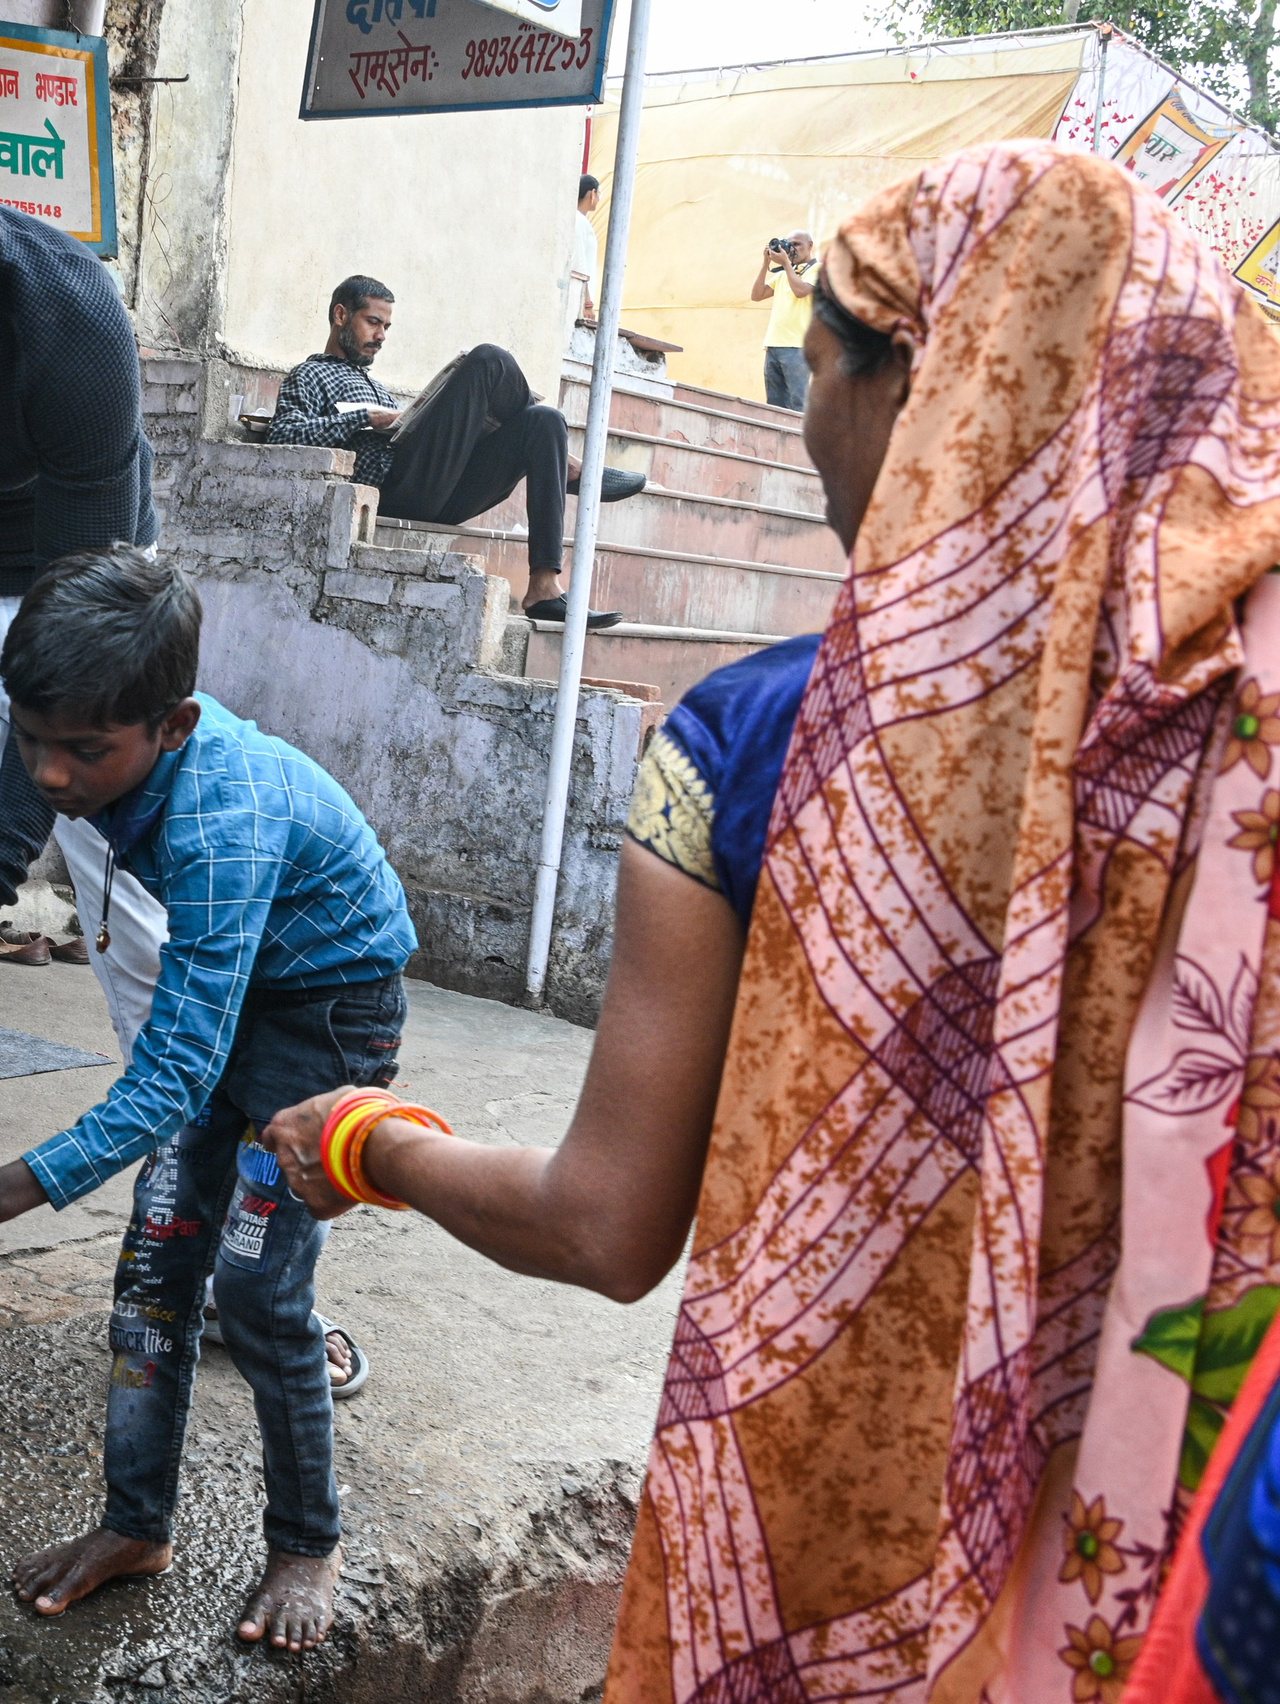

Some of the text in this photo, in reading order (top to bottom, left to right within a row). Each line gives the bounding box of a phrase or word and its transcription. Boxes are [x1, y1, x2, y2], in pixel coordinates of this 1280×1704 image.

[461, 27, 593, 80] 9893647253
[36, 72, 78, 107] भण्डार
[145, 1326, 173, 1354] like
